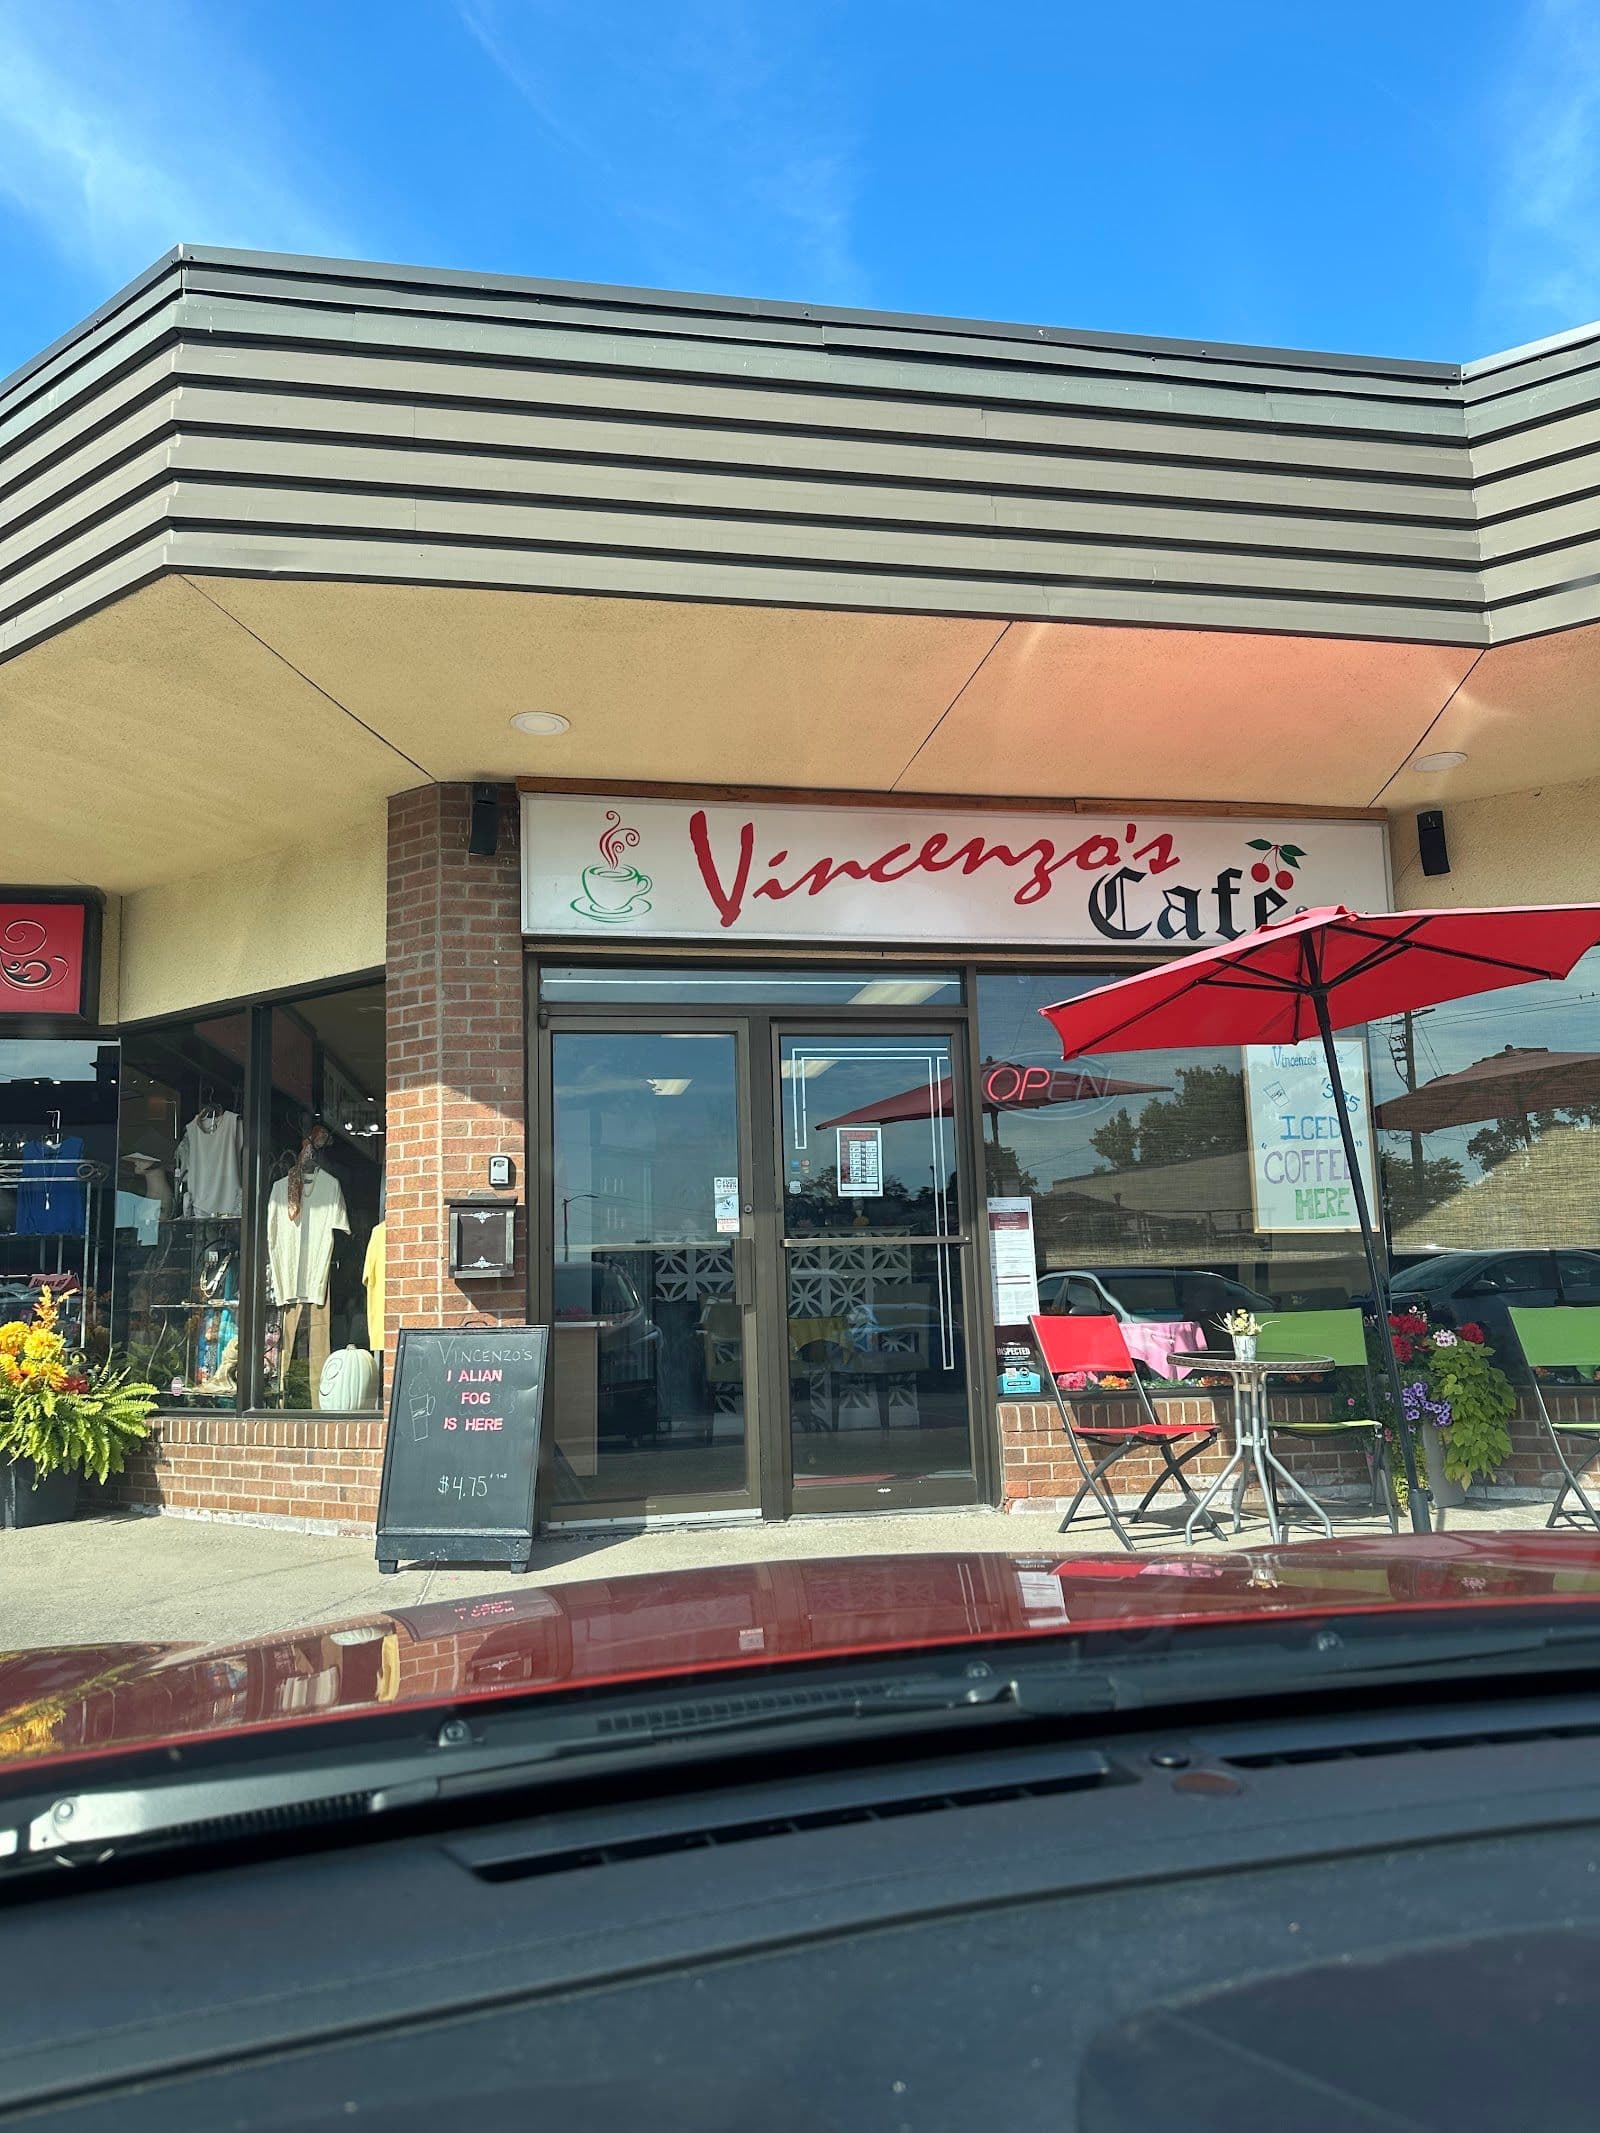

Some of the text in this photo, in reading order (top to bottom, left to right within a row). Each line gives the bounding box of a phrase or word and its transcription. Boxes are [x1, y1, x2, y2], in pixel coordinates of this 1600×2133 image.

[689, 810, 1181, 928] Vincenzo's
[1272, 1046, 1317, 1068] Vincenzo's
[986, 1066, 1113, 1101] OPEN
[1280, 1115, 1341, 1141] ICED
[1295, 1187, 1351, 1221] HERE
[458, 1369, 503, 1383] ALIAN
[461, 1392, 491, 1405] FOG
[443, 1417, 504, 1431] IS HERE
[437, 1474, 488, 1500] $4.75
